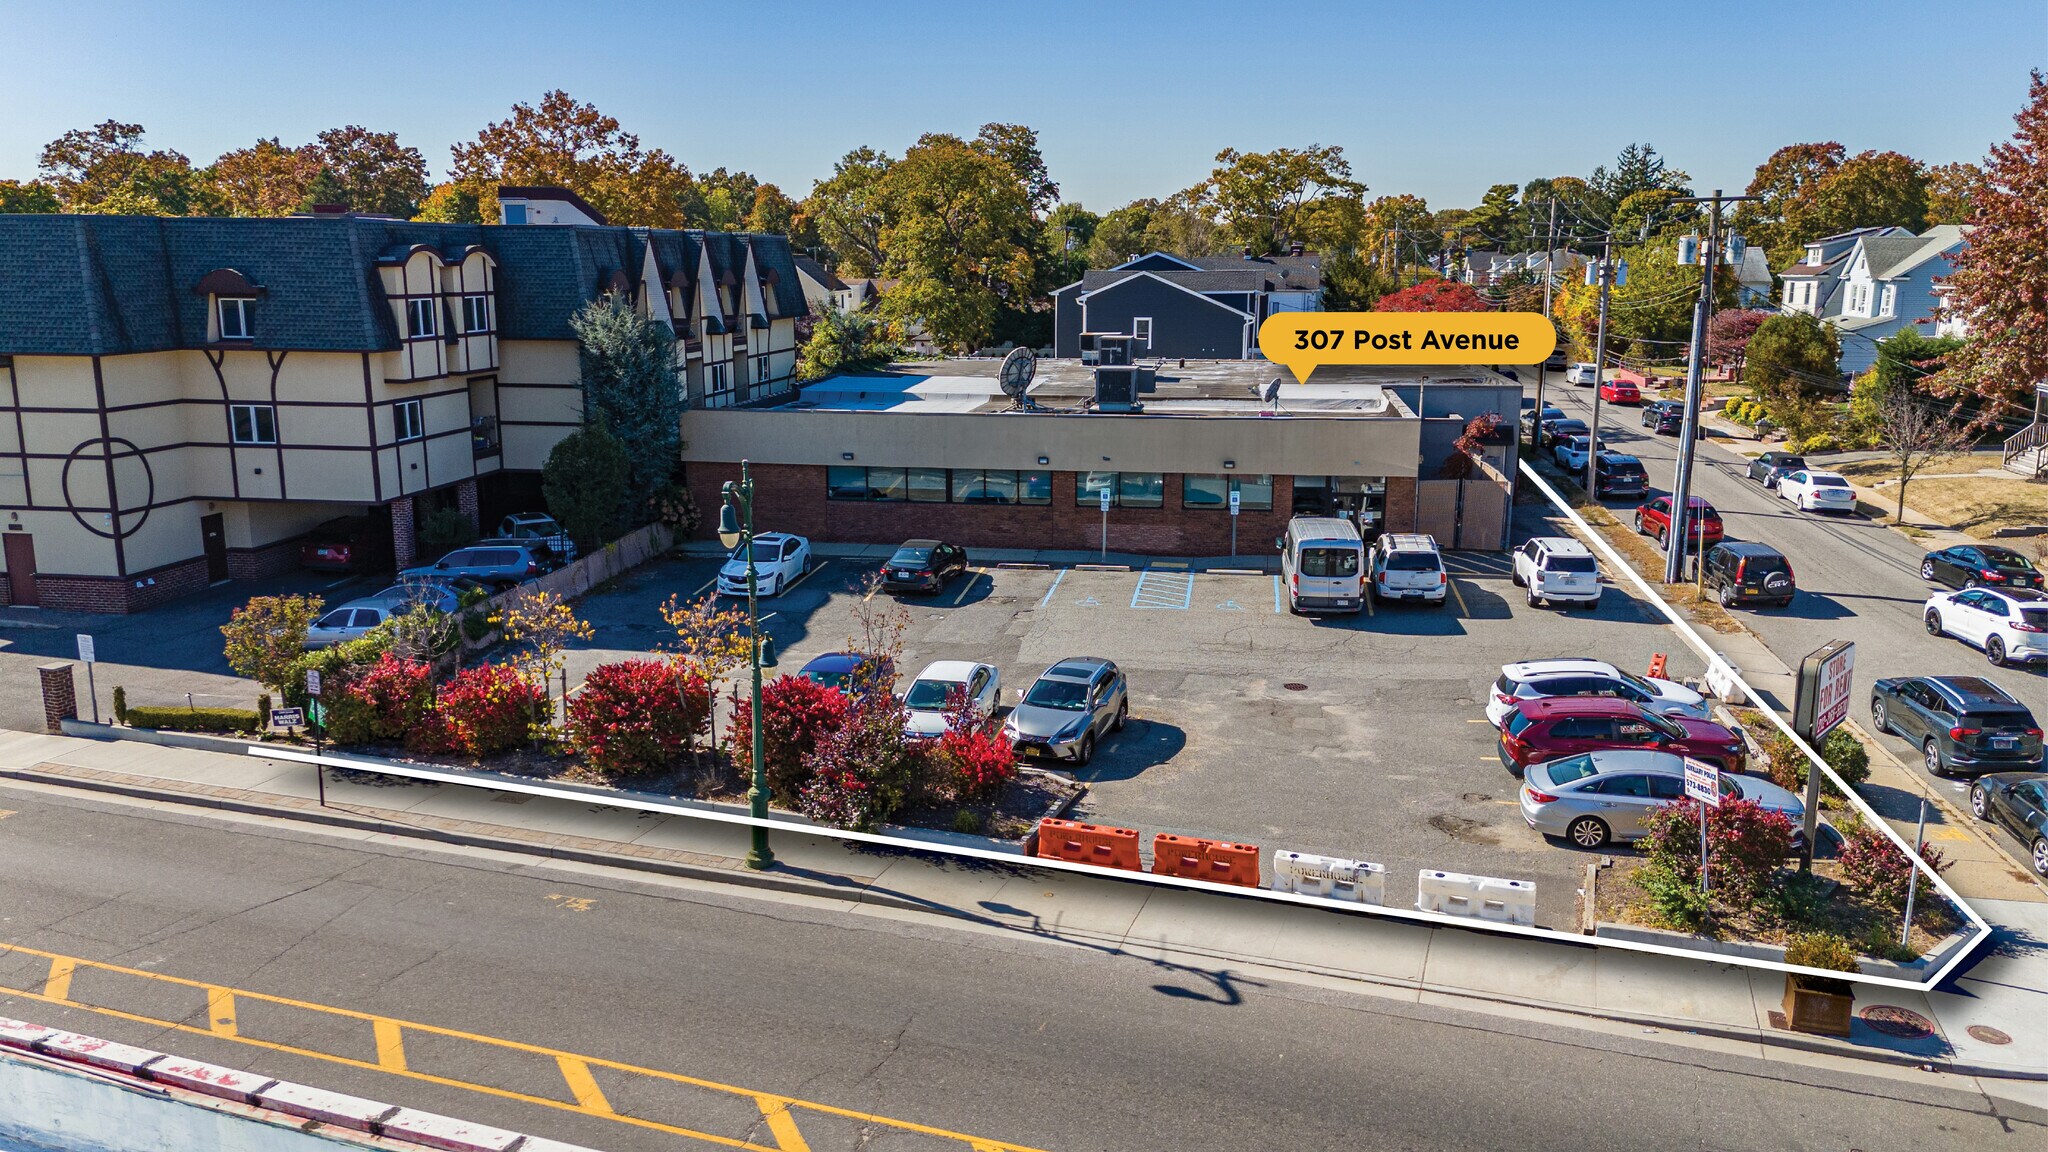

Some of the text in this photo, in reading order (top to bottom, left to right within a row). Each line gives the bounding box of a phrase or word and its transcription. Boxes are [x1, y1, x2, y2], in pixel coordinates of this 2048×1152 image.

[1829, 653, 1846, 680] STORE
[1819, 669, 1851, 712] FOR RENT
[1703, 770, 1717, 782] POLICE
